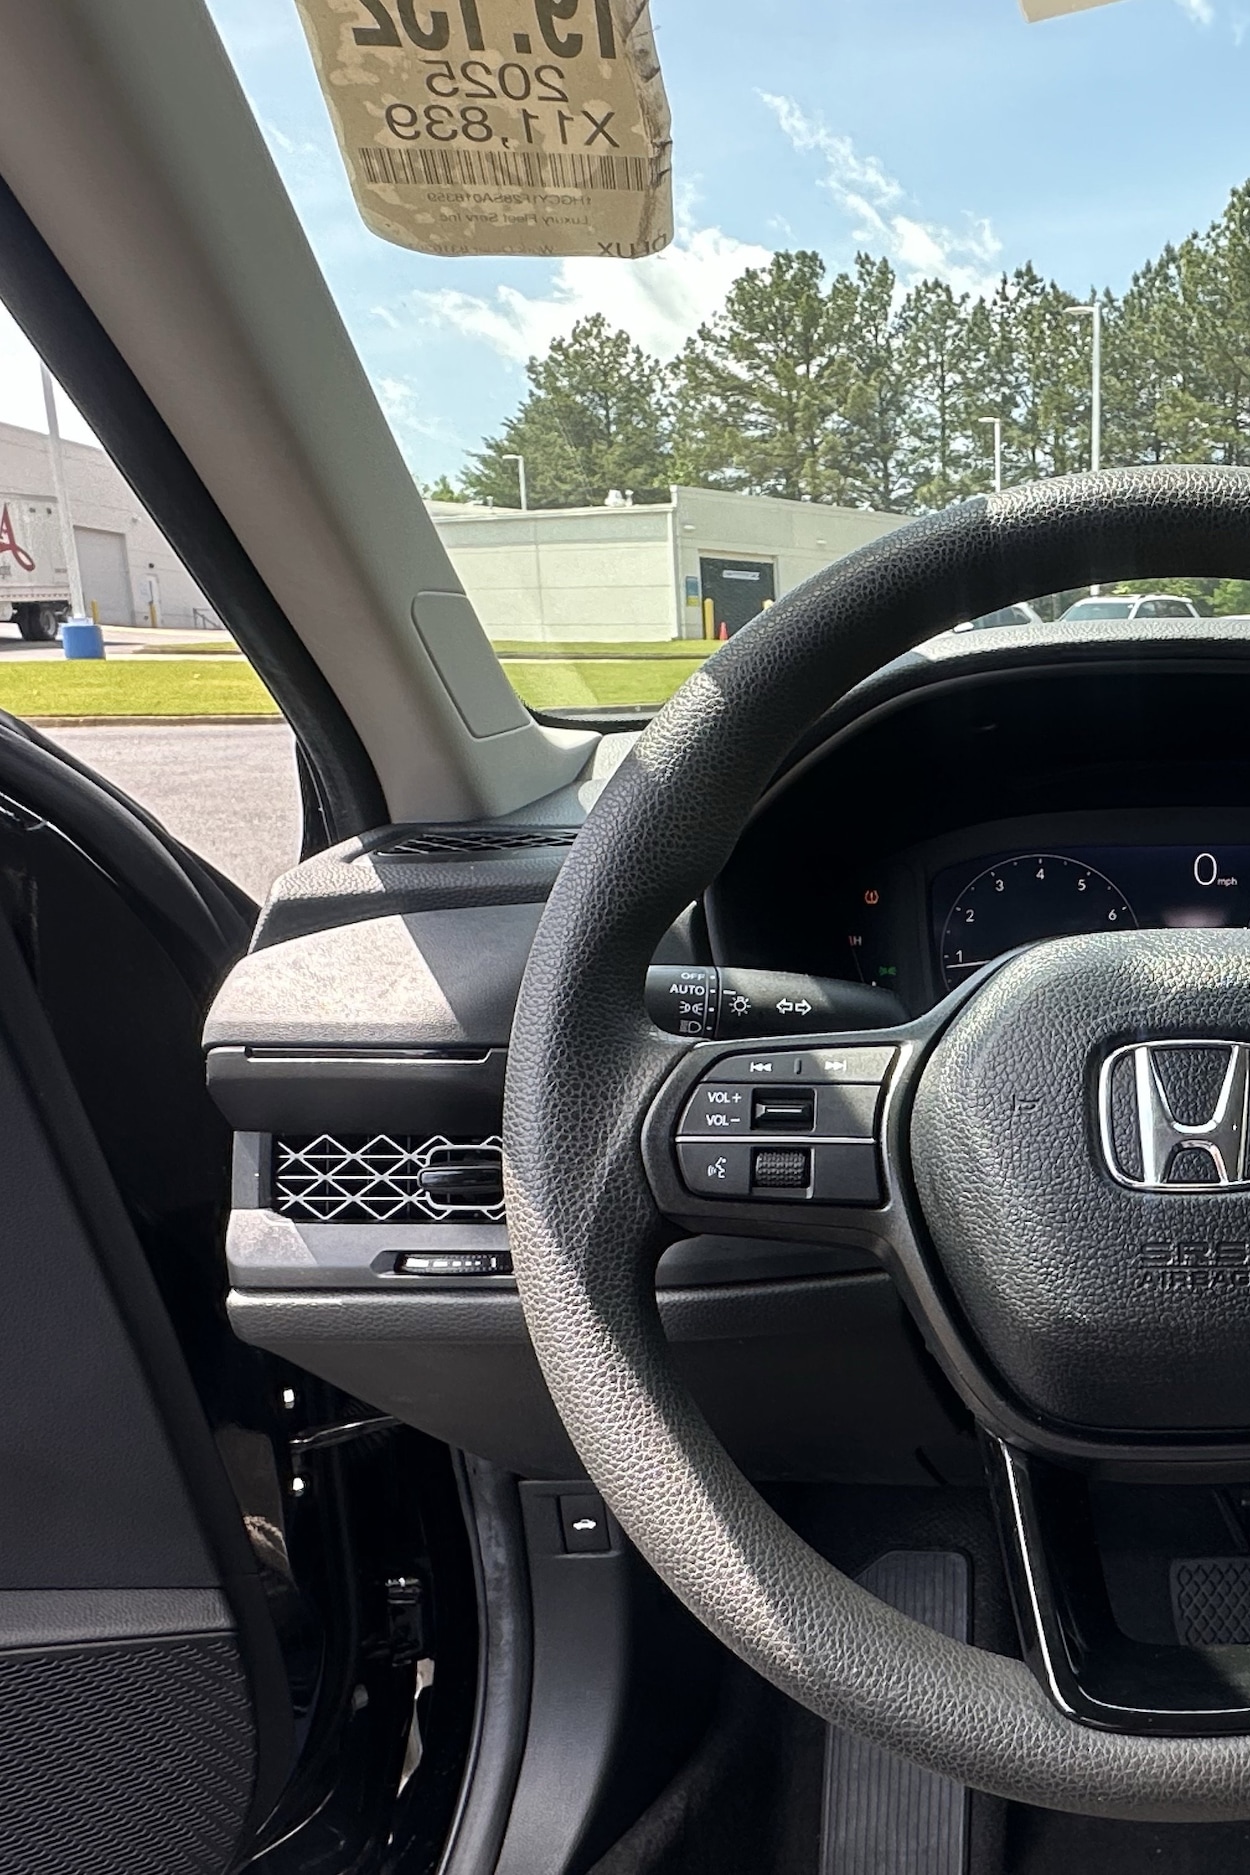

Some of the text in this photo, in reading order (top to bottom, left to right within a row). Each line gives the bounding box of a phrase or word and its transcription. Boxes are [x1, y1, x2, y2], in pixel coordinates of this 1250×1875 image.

[1035, 868, 1045, 880] 4
[995, 879, 1005, 892] 3
[1077, 879, 1087, 891] 5
[1217, 877, 1238, 887] mph
[965, 909, 975, 922] 2
[1108, 909, 1118, 921] 6
[955, 950, 963, 962] 1
[681, 972, 705, 981] OFF
[670, 984, 705, 996] AUTO
[1137, 1241, 1250, 1267] SRS
